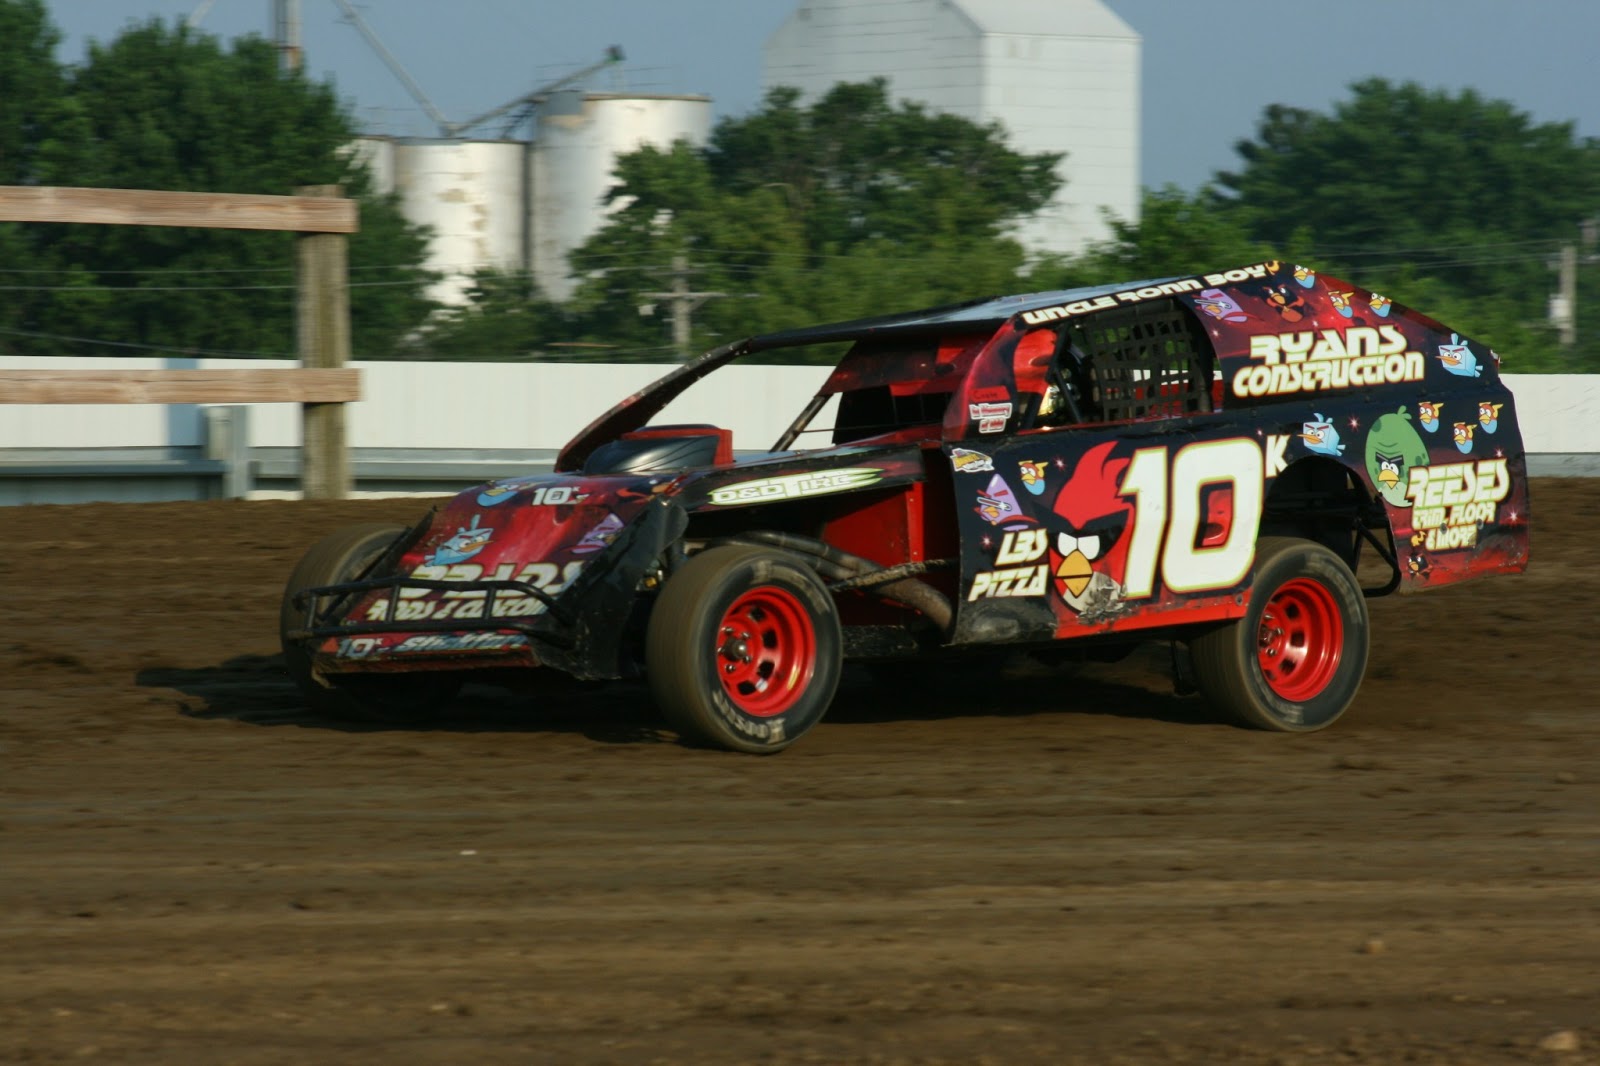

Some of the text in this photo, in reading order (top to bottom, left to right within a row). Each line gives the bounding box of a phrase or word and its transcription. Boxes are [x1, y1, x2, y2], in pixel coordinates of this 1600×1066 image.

[1021, 294, 1119, 325] UNCLE
[1204, 264, 1267, 286] BOY
[1250, 325, 1408, 366] RYANS
[1232, 351, 1425, 397] CONSTRUCTION
[714, 473, 851, 502] D&D TIRE
[1406, 458, 1510, 507] REESES
[1449, 501, 1496, 525] FLOOR
[1436, 525, 1477, 550] MORE
[968, 564, 1048, 602] PIZZA
